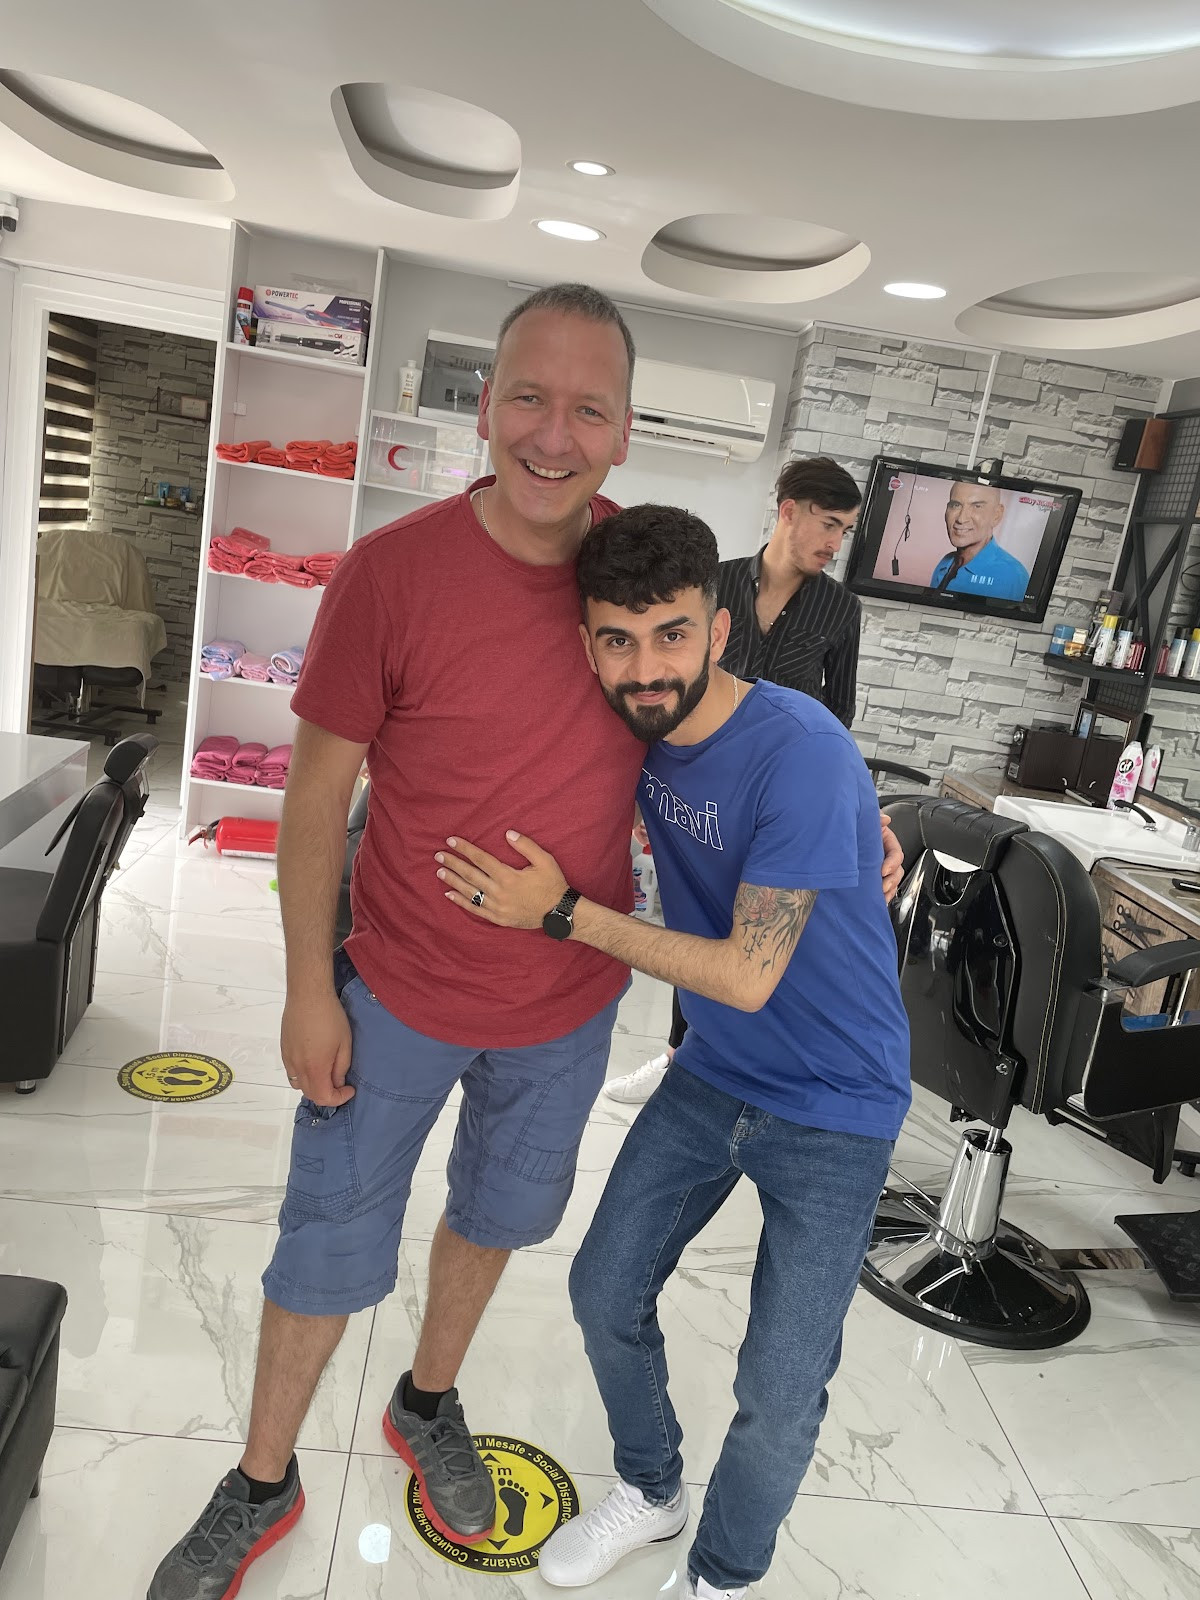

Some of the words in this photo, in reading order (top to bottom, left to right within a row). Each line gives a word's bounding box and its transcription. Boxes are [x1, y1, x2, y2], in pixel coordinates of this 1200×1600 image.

[271, 290, 299, 299] POWERTEC
[485, 1437, 526, 1455] Mesafe
[497, 1467, 512, 1476] m
[532, 1453, 562, 1482] Social
[556, 1481, 573, 1524] Distance
[413, 1507, 469, 1563] Социальная
[482, 1555, 531, 1568] Distanz
